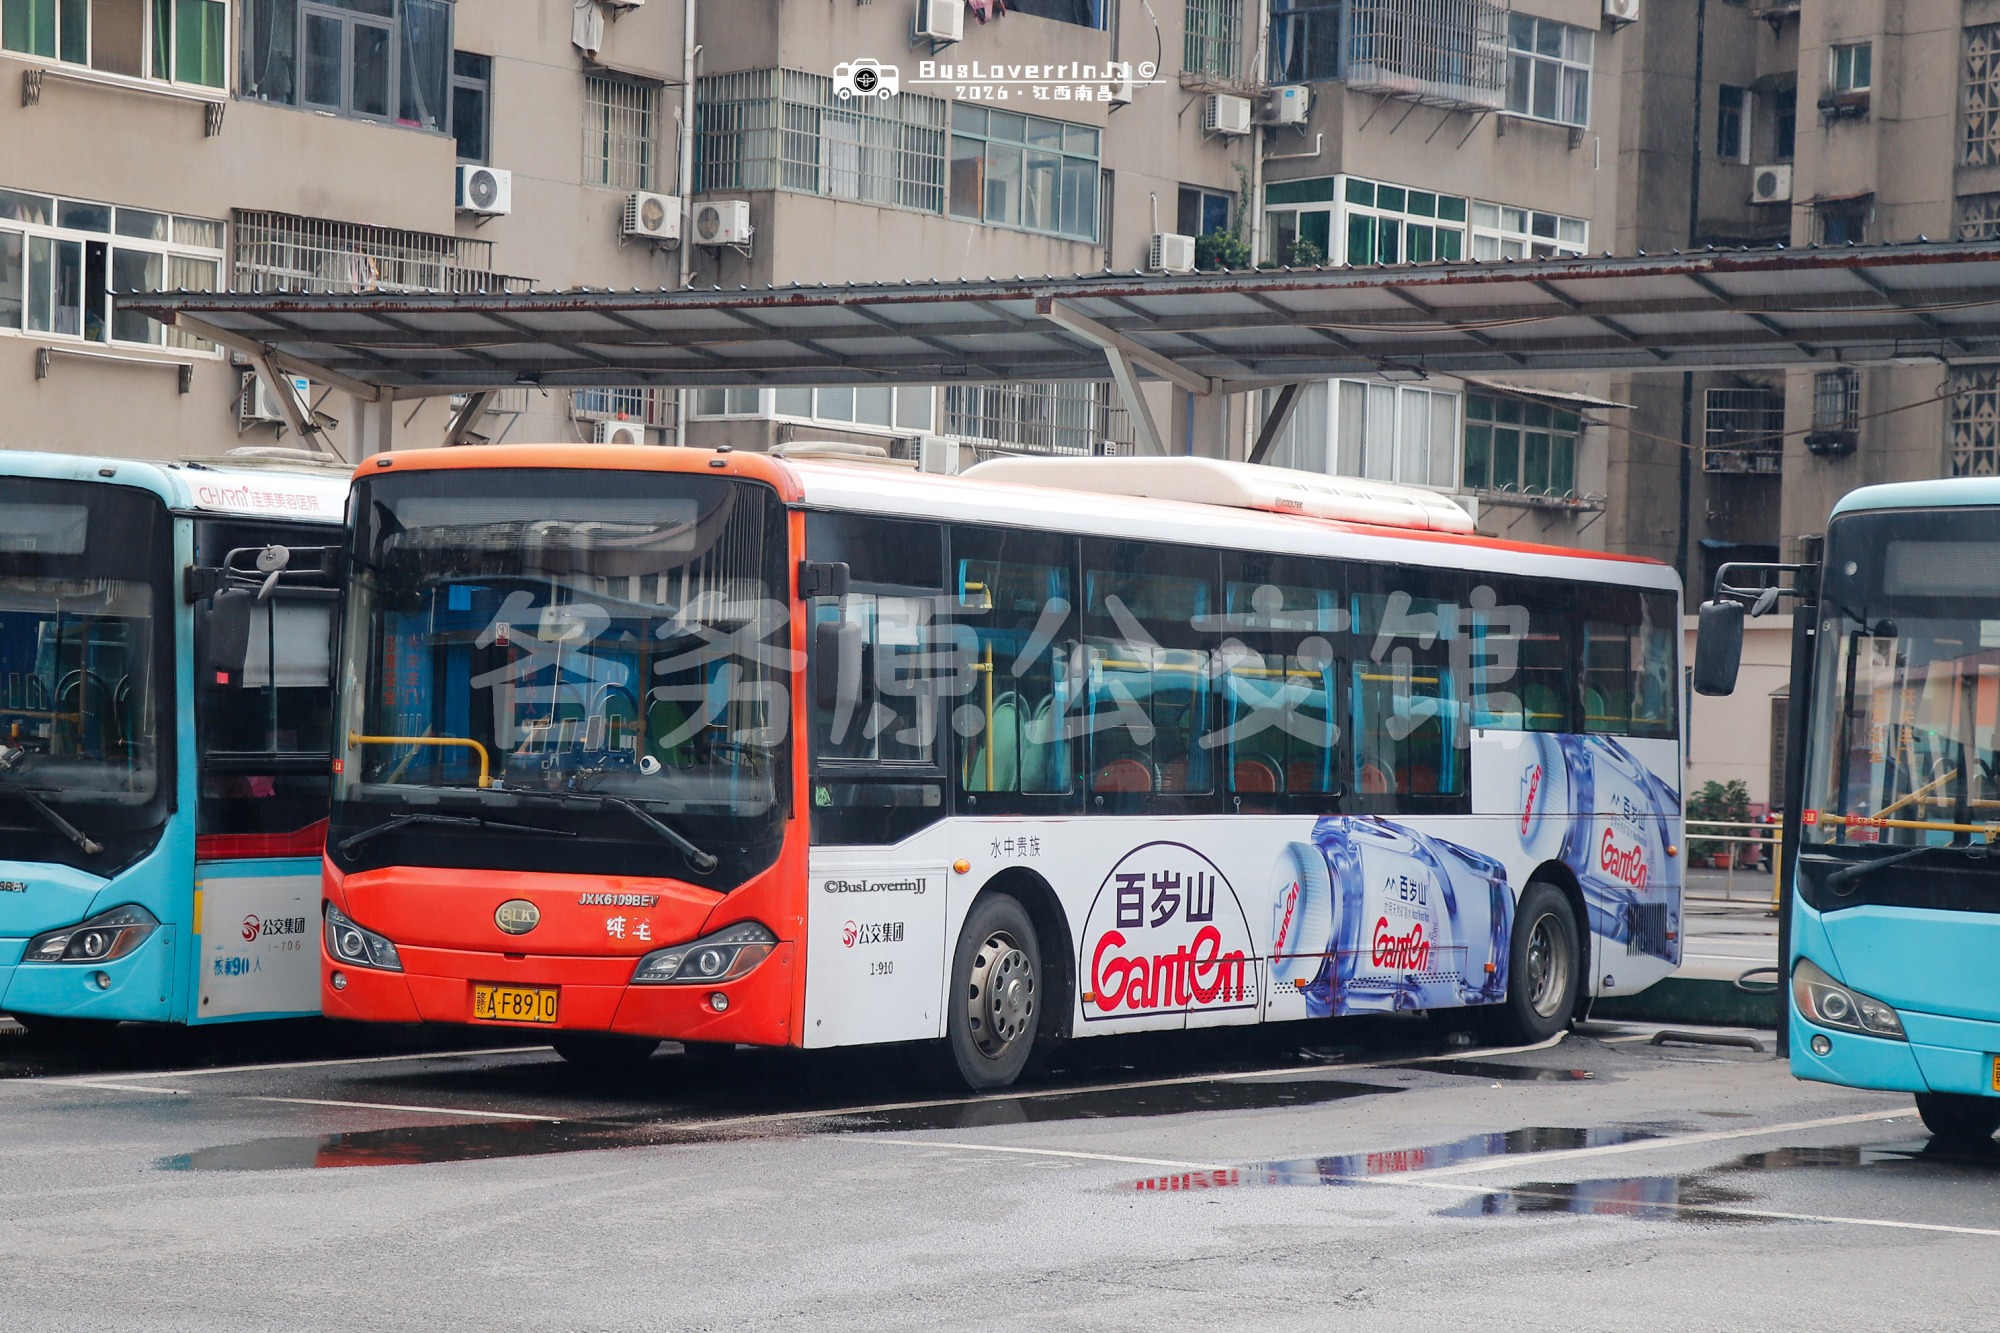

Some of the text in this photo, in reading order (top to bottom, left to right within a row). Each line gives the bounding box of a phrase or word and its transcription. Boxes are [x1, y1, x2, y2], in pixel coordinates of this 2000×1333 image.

[990, 835, 1041, 859] 水中贵族
[1601, 827, 1648, 892] Ganten
[578, 892, 660, 907] JXK6109BEV
[1115, 870, 1215, 929] 百岁山
[1399, 874, 1428, 906] 百岁山
[262, 917, 306, 936] 公交集团
[858, 921, 904, 945] 公交集团
[1372, 916, 1430, 971] Ganten
[870, 961, 894, 976] 1-910
[1091, 925, 1245, 1012] Ganten
